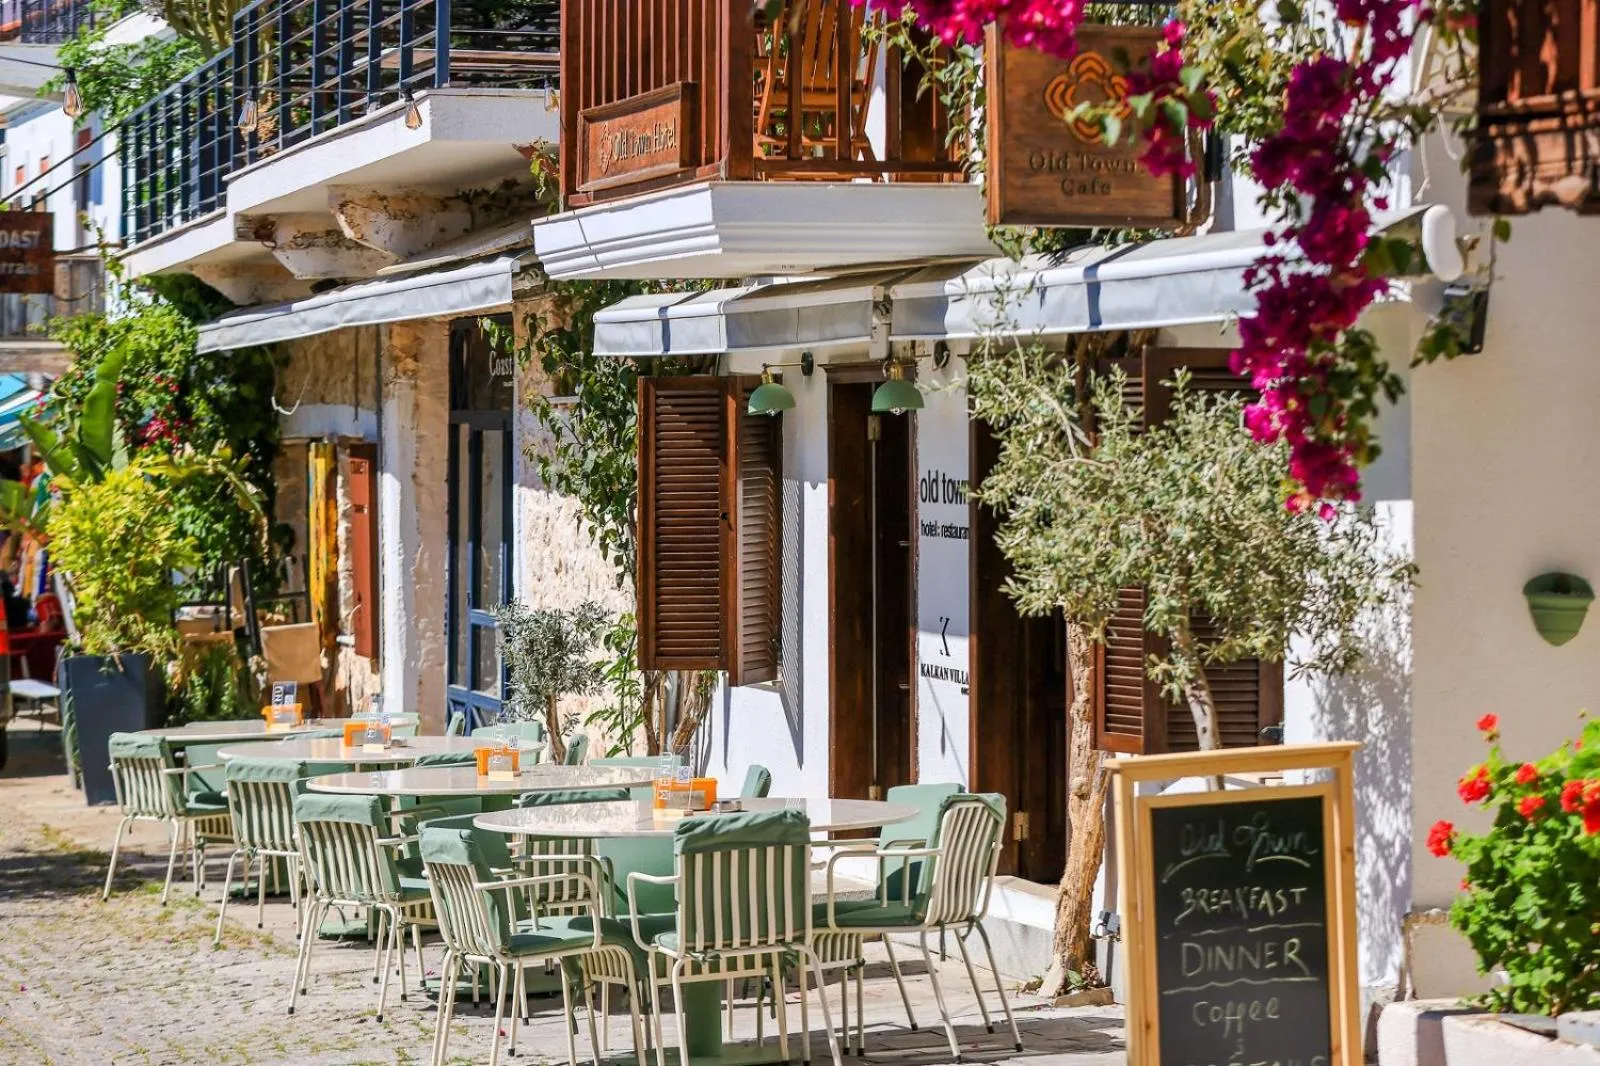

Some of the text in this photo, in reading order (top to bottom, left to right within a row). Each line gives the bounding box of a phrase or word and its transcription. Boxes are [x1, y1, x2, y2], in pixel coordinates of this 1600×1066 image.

[653, 117, 677, 153] Hotel
[1029, 151, 1138, 173] Old Town
[489, 350, 513, 377] Coast
[920, 469, 939, 503] old
[920, 663, 949, 681] KALKAN
[656, 752, 673, 800] MENU
[1180, 818, 1230, 857] Old
[1174, 887, 1308, 925] BREAKFAST
[1181, 938, 1311, 977] DINNER
